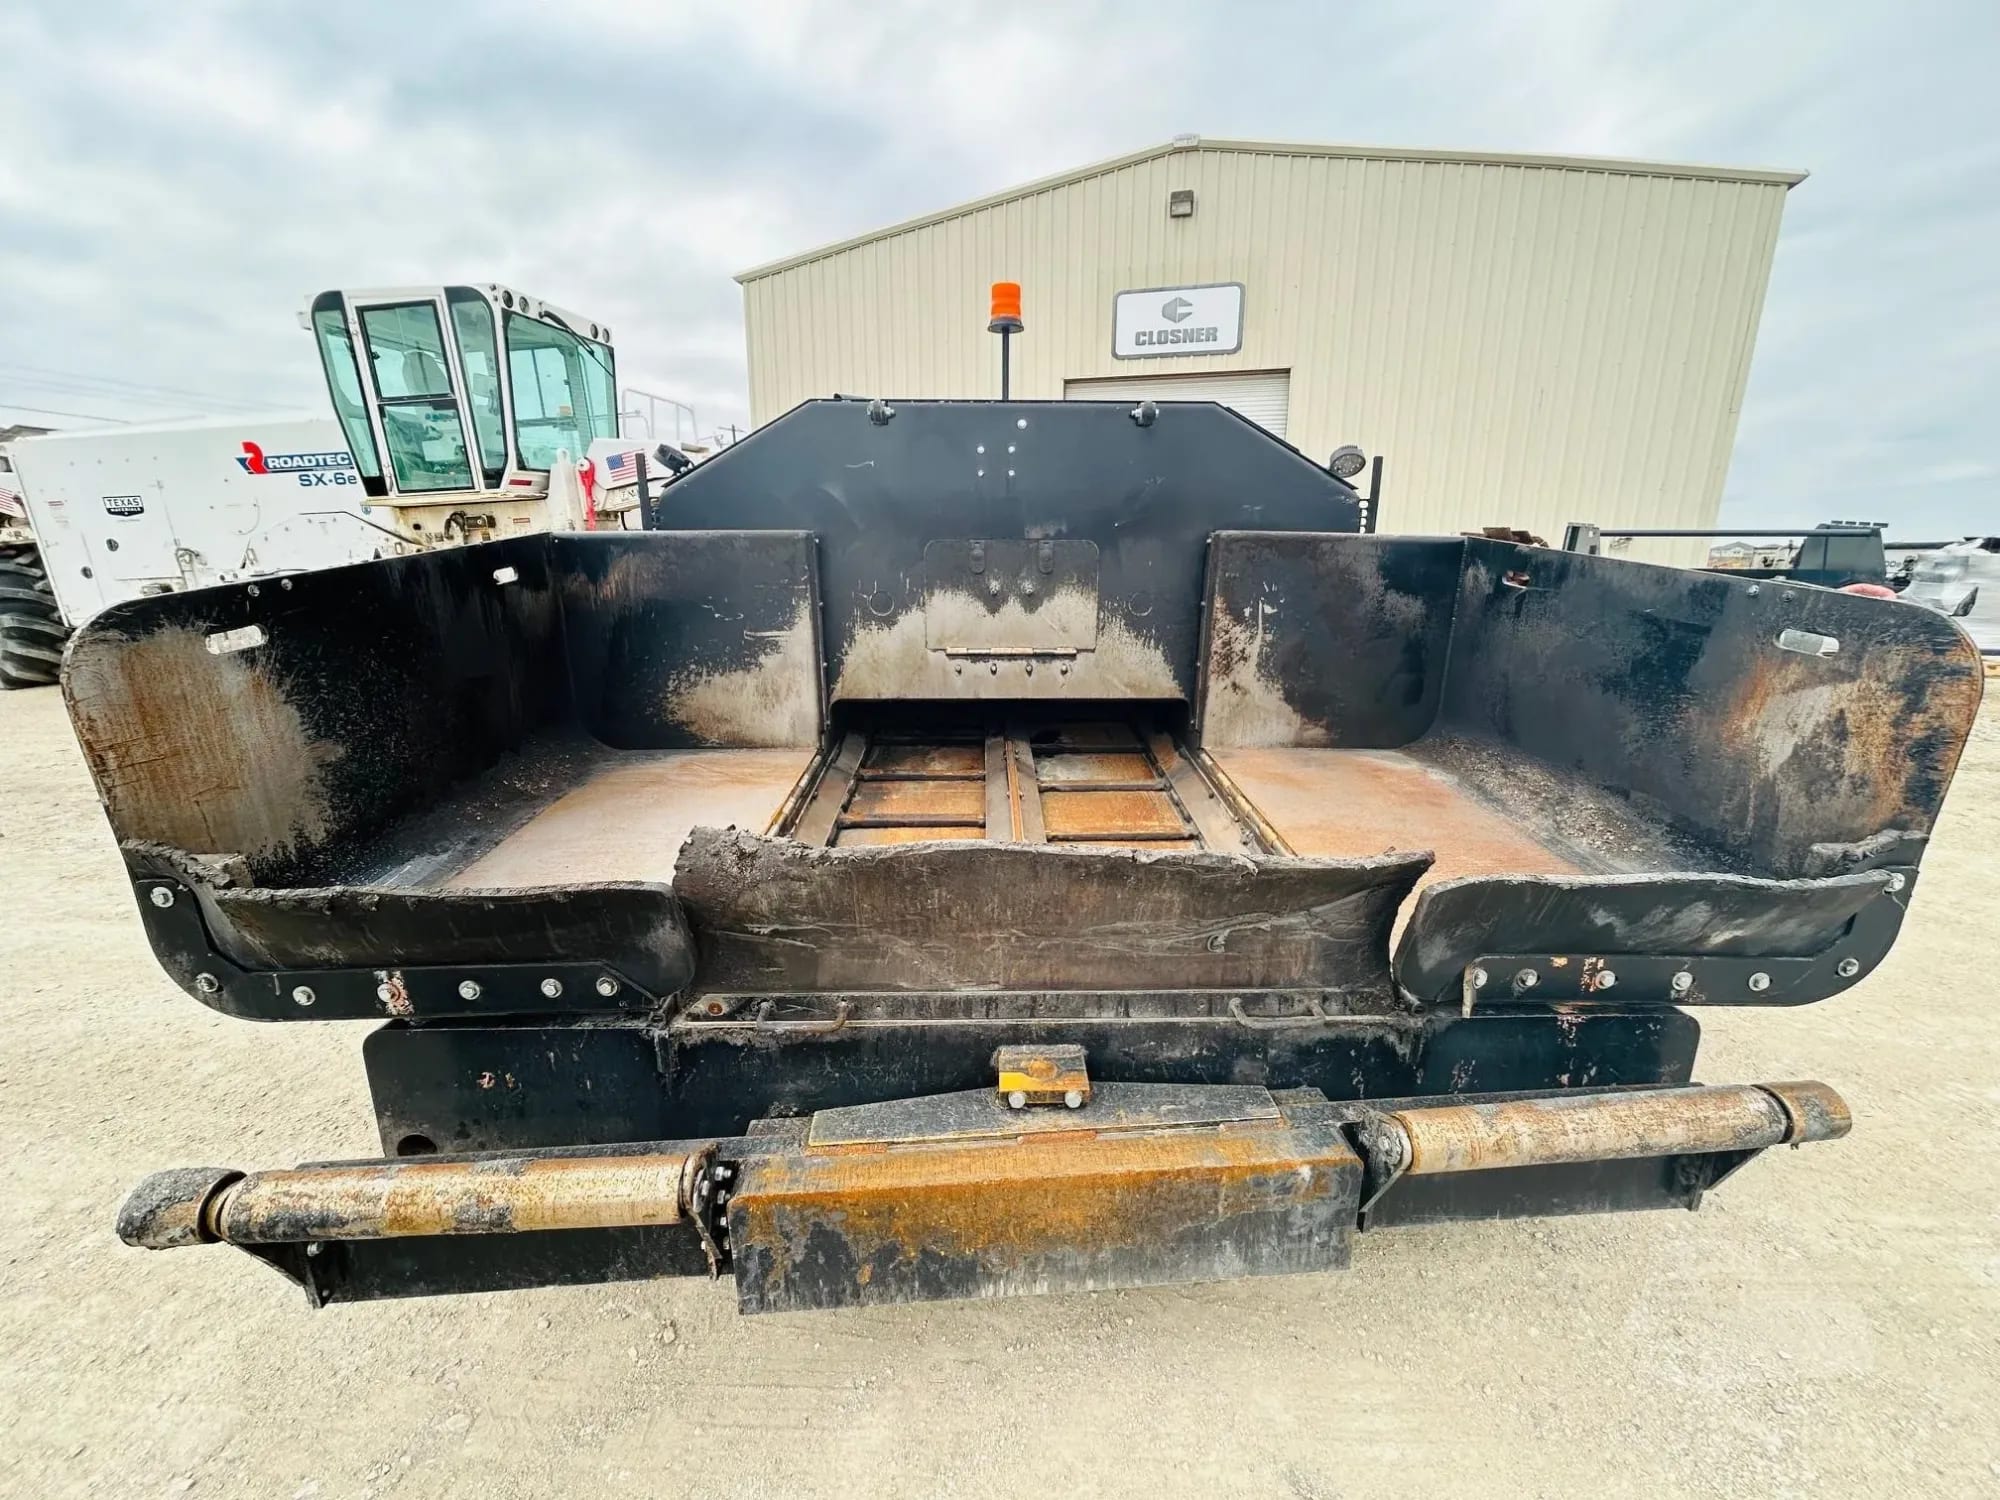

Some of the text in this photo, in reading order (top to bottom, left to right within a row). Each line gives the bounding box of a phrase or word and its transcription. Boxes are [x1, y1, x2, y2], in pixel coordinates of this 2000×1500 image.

[1135, 327, 1218, 346] CLOSNER
[266, 454, 350, 468] ROADTEC
[107, 498, 140, 507] TEXAS
